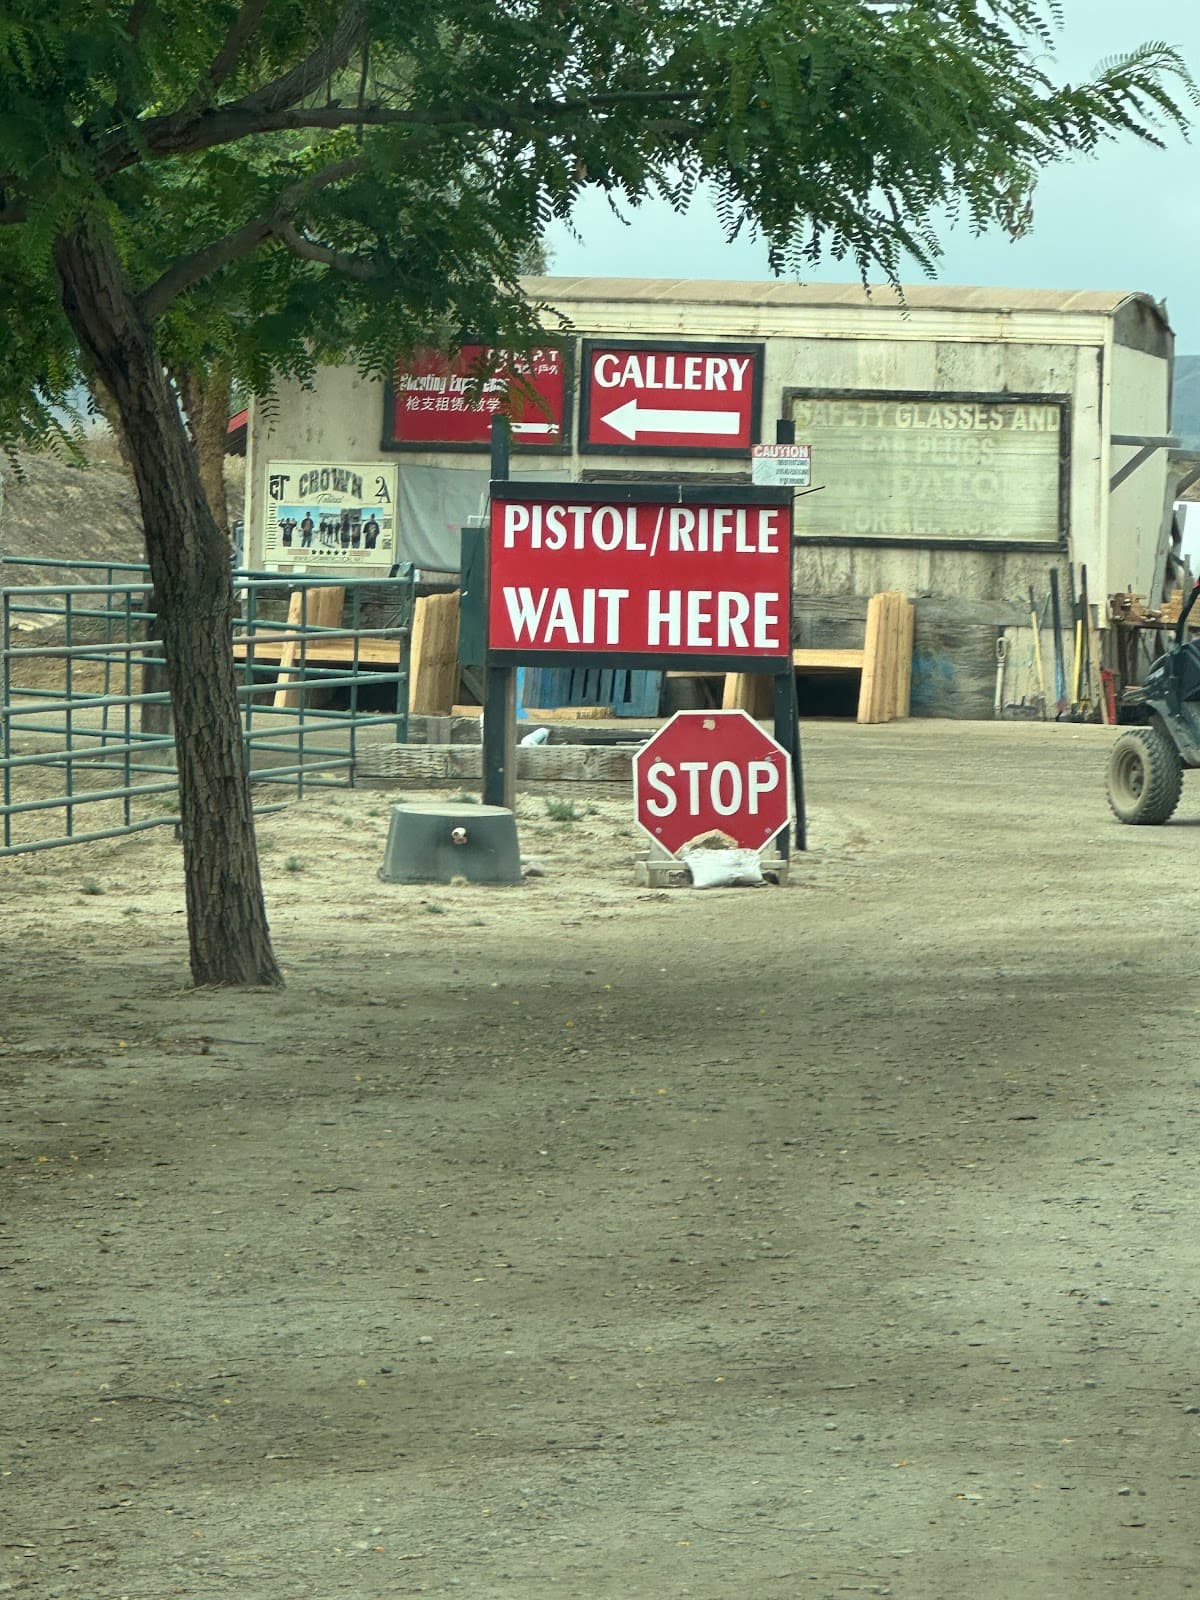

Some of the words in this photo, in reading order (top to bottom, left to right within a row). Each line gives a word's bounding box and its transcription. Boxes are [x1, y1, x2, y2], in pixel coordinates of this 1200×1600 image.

[594, 354, 750, 391] GALLERY
[796, 402, 892, 428] SAFETY
[895, 404, 1003, 431] GLASSES
[1010, 405, 1061, 432] AND
[754, 445, 808, 458] CAUTION
[299, 467, 363, 499] CROWN
[503, 505, 779, 556] PISTOL/RIFLE
[503, 587, 629, 645] WAIT
[647, 589, 780, 648] HERE
[646, 761, 779, 817] STOP
